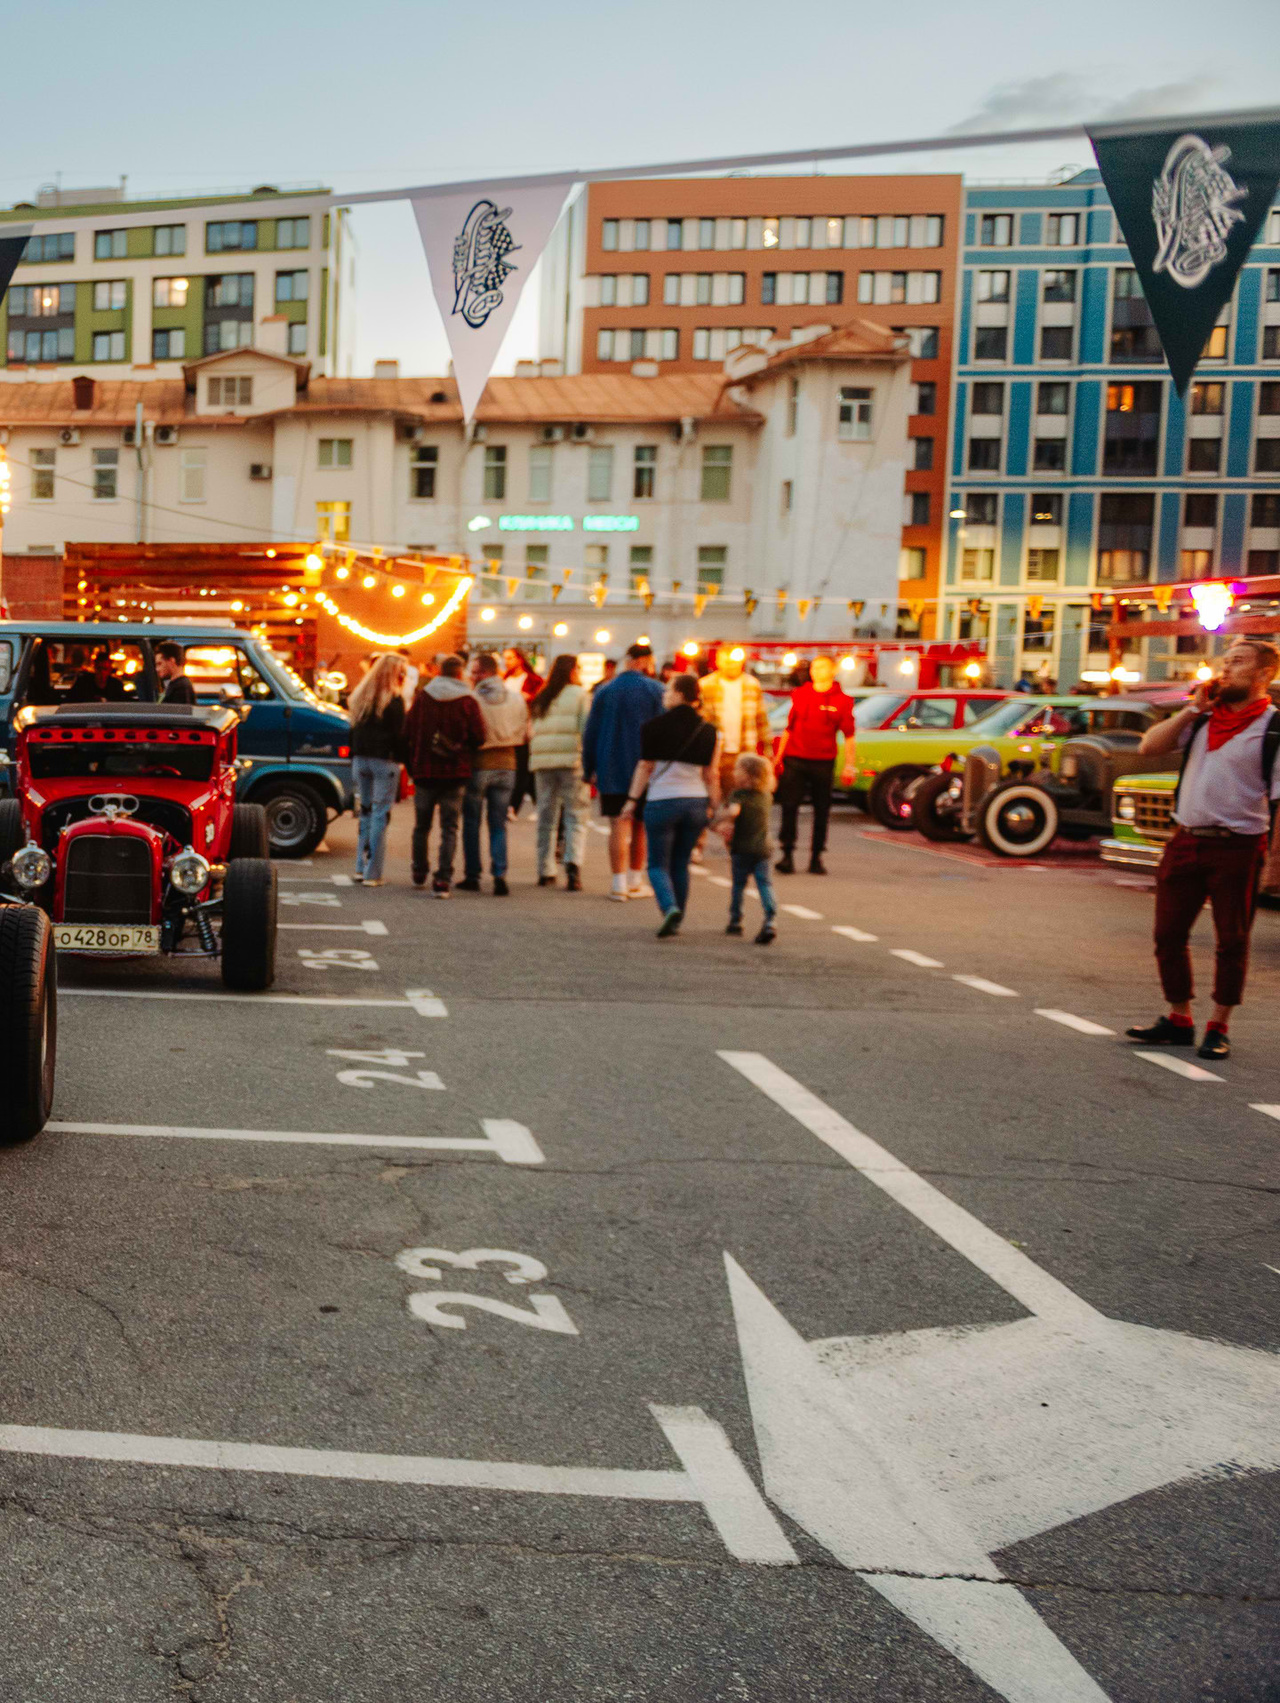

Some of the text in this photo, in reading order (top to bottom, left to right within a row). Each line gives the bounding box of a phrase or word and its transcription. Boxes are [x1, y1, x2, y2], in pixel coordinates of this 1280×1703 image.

[136, 931, 152, 943] 78
[297, 949, 379, 970] 25
[325, 1048, 448, 1090] 24
[394, 1246, 580, 1335] 23
